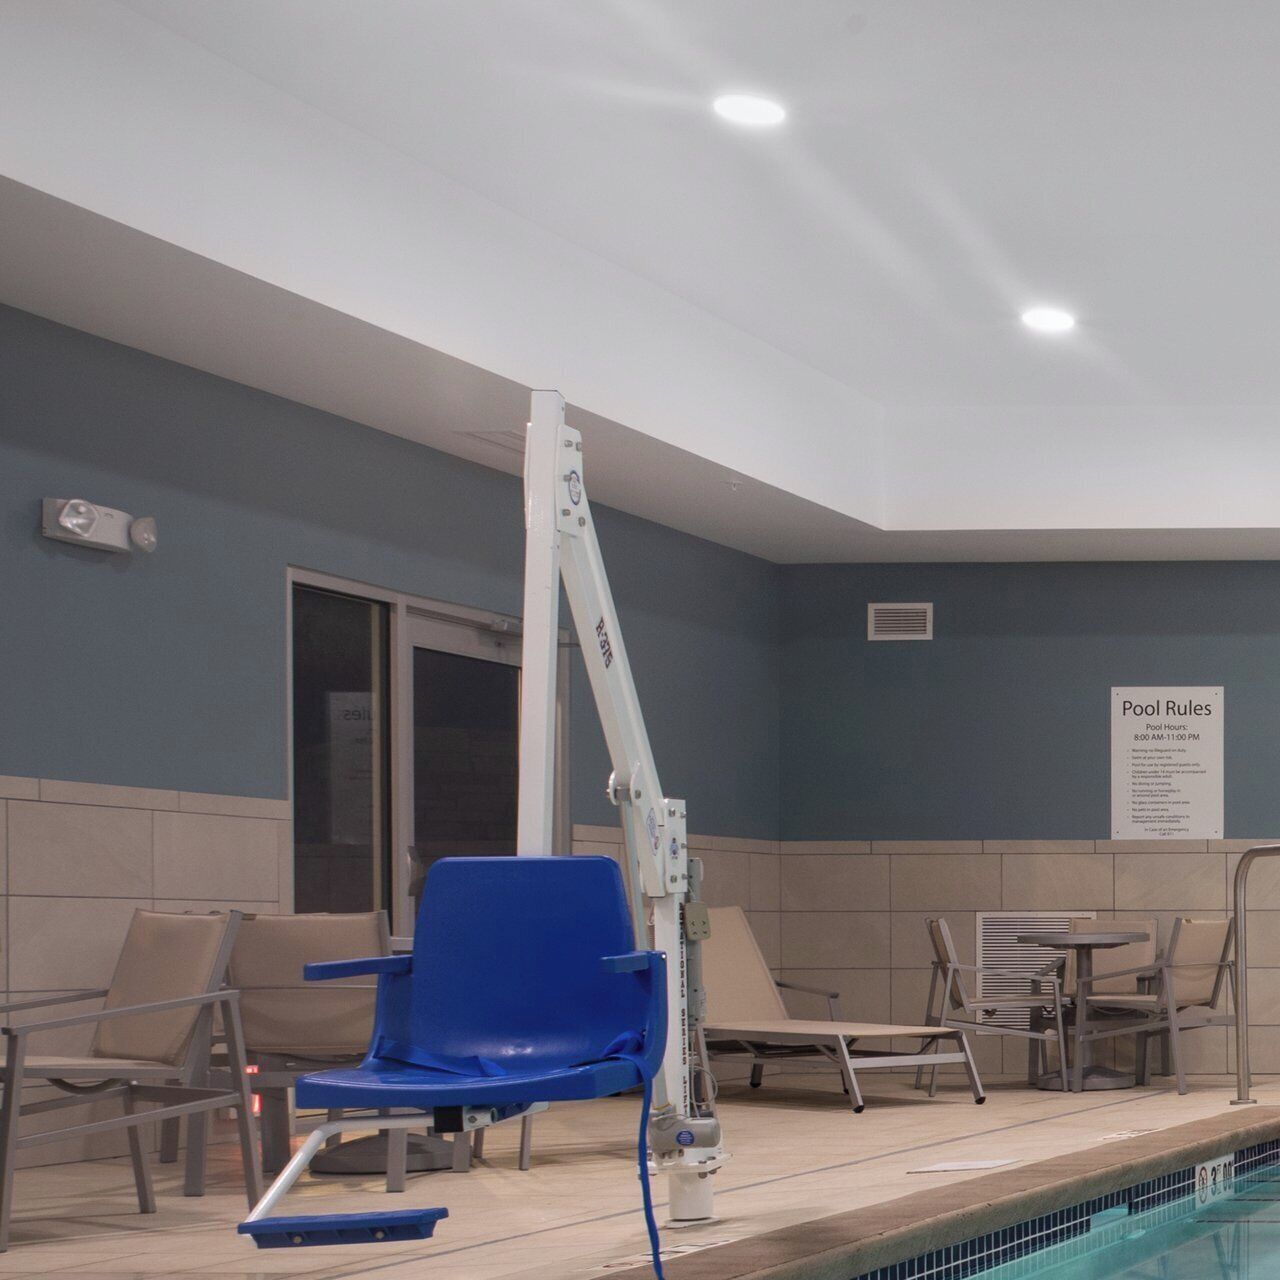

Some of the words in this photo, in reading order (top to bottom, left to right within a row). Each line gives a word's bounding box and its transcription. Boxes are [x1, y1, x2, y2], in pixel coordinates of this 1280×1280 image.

[1122, 700, 1160, 716] Pool
[1166, 700, 1212, 716] Rules
[1146, 723, 1162, 731] Pool
[1164, 723, 1188, 731] Hours:
